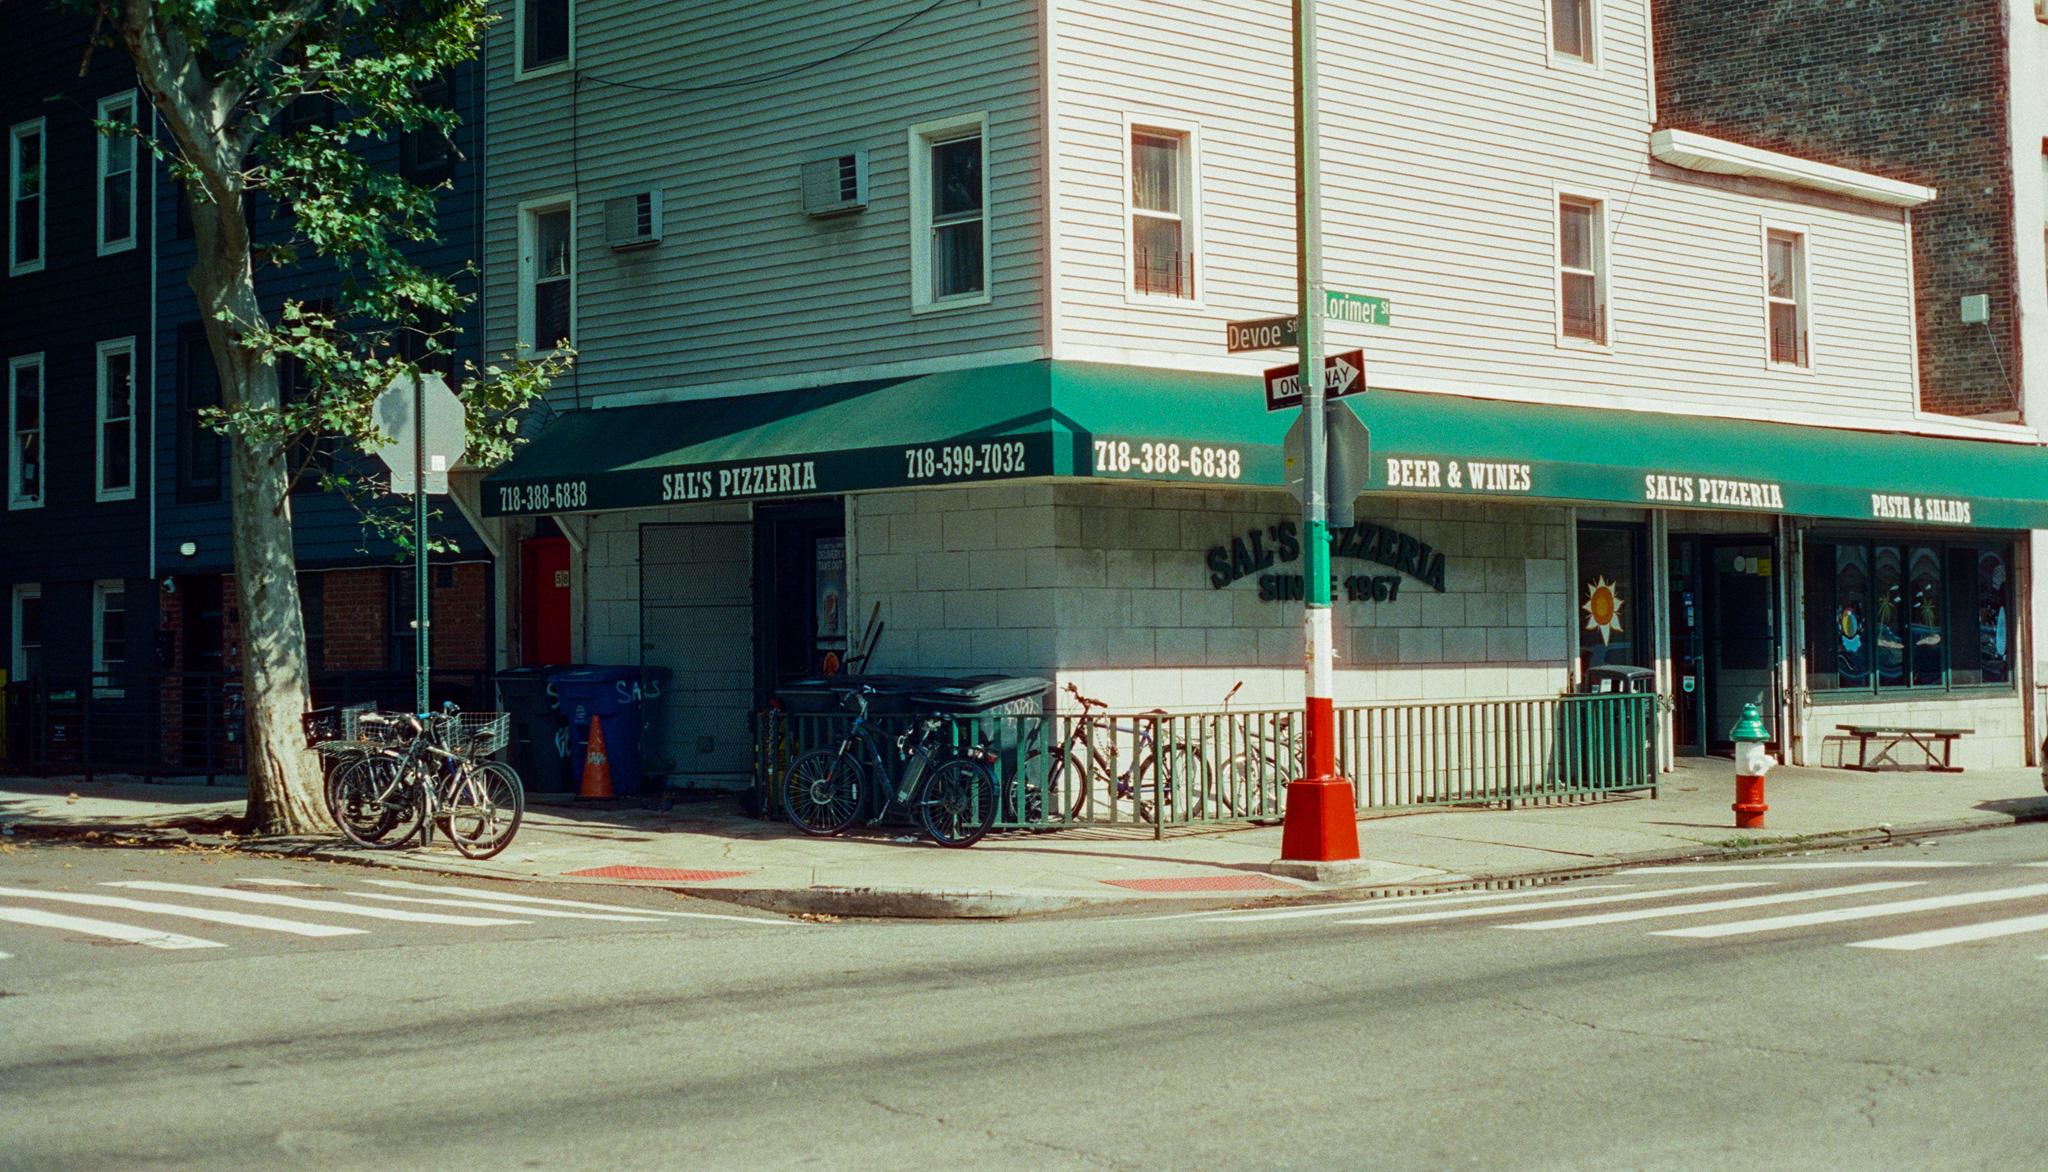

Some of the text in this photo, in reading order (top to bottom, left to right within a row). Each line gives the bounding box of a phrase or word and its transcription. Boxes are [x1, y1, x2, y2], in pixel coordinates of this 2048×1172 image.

[1324, 293, 1390, 323] Lorimer St
[1229, 320, 1297, 349] Devoe St
[1280, 377, 1300, 395] ON
[906, 442, 1025, 478] 718-599-7032
[1095, 441, 1241, 479] 718-388-6838
[1387, 459, 1531, 491] BEER & WINES
[663, 461, 817, 501] SAL'S PIZZERIA
[1646, 475, 1784, 509] SAL'S PIZZERIA
[500, 482, 588, 512] 718-388-6838
[1872, 494, 1971, 524] PASTA & SALADS
[1207, 521, 1446, 593] SAL'S IZZERIA
[1259, 575, 1402, 602] SINE 1967
